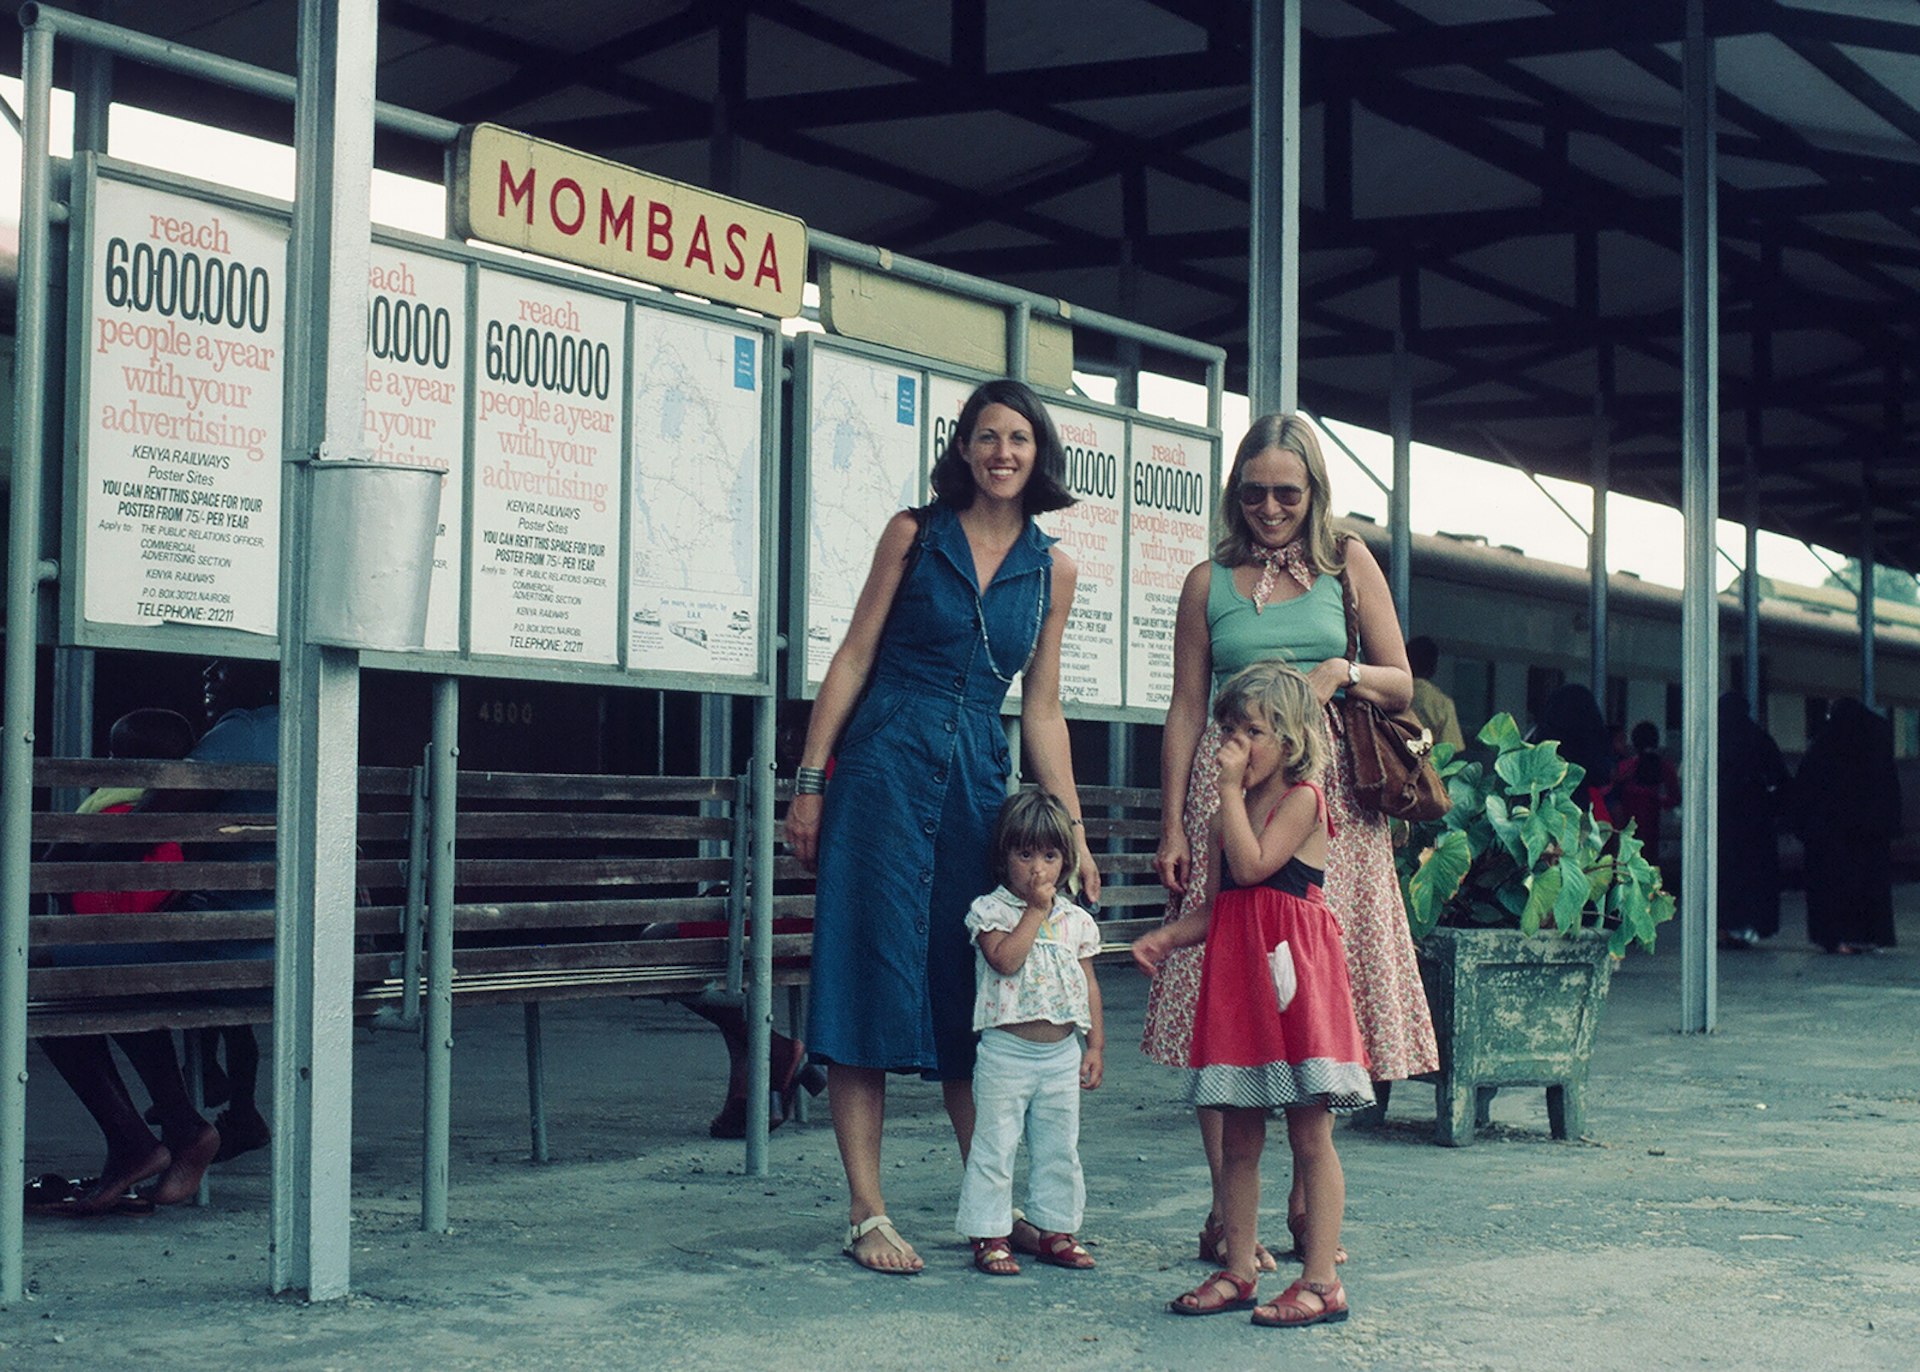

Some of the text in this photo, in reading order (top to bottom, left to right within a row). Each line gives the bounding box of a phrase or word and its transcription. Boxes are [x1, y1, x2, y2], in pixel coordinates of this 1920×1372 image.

[150, 214, 231, 254] reach
[498, 159, 782, 293] MOMBASA
[106, 237, 269, 333] 6,000,000
[519, 299, 581, 332] reach
[97, 317, 275, 373] people a year
[368, 295, 450, 369] 0,000
[486, 320, 610, 400] 6,000,000
[121, 362, 252, 411] with your
[386, 372, 402, 396] a
[402, 375, 455, 407] year
[479, 389, 614, 436] people a year
[101, 400, 267, 462] advertising
[378, 411, 436, 443] your
[1060, 422, 1097, 447] reach
[132, 444, 230, 470] KENYA RAILWAYS
[497, 426, 597, 470] with your
[1152, 443, 1186, 466] reach
[148, 465, 215, 486] Poster Sites
[483, 460, 608, 512] advertising
[1134, 461, 1203, 516] 6,000,000
[102, 480, 263, 513] YOU CAN RENT THIS SPACE FOR YOUR
[505, 499, 581, 520] KENYA RAILWAYS
[98, 519, 121, 532] Apply
[117, 501, 155, 519] POSTER
[156, 506, 183, 522] FROM
[206, 511, 224, 527] PER
[226, 514, 249, 529] YEAR
[518, 517, 569, 535] Poster Sites
[1081, 504, 1089, 520] a
[1088, 504, 1119, 528] year
[1130, 512, 1205, 543] people a year
[140, 538, 196, 553] COMMERCIAL
[141, 523, 157, 535] THE
[158, 525, 186, 538] PUBLIC
[188, 529, 231, 543] RELATIONS
[483, 530, 605, 557] YOU CAN RENT THIS SPACE FOR YOUR
[1077, 531, 1108, 554] your
[140, 551, 231, 568] ADVERTISING SECTION
[495, 548, 523, 563] POSTER
[525, 552, 545, 567] FROM
[562, 556, 577, 569] PER
[577, 558, 595, 572] YEAR
[1140, 539, 1196, 568] with your
[145, 569, 215, 584] KENYA RAILWAYS
[512, 580, 554, 593] COMMERCIAL
[526, 568, 547, 580] PUBLIC
[549, 572, 582, 585] RELATIONS
[158, 588, 175, 599] BOX
[512, 591, 582, 605] ADVERTISING SECTION
[137, 602, 234, 622] TELEPHONE: 21211
